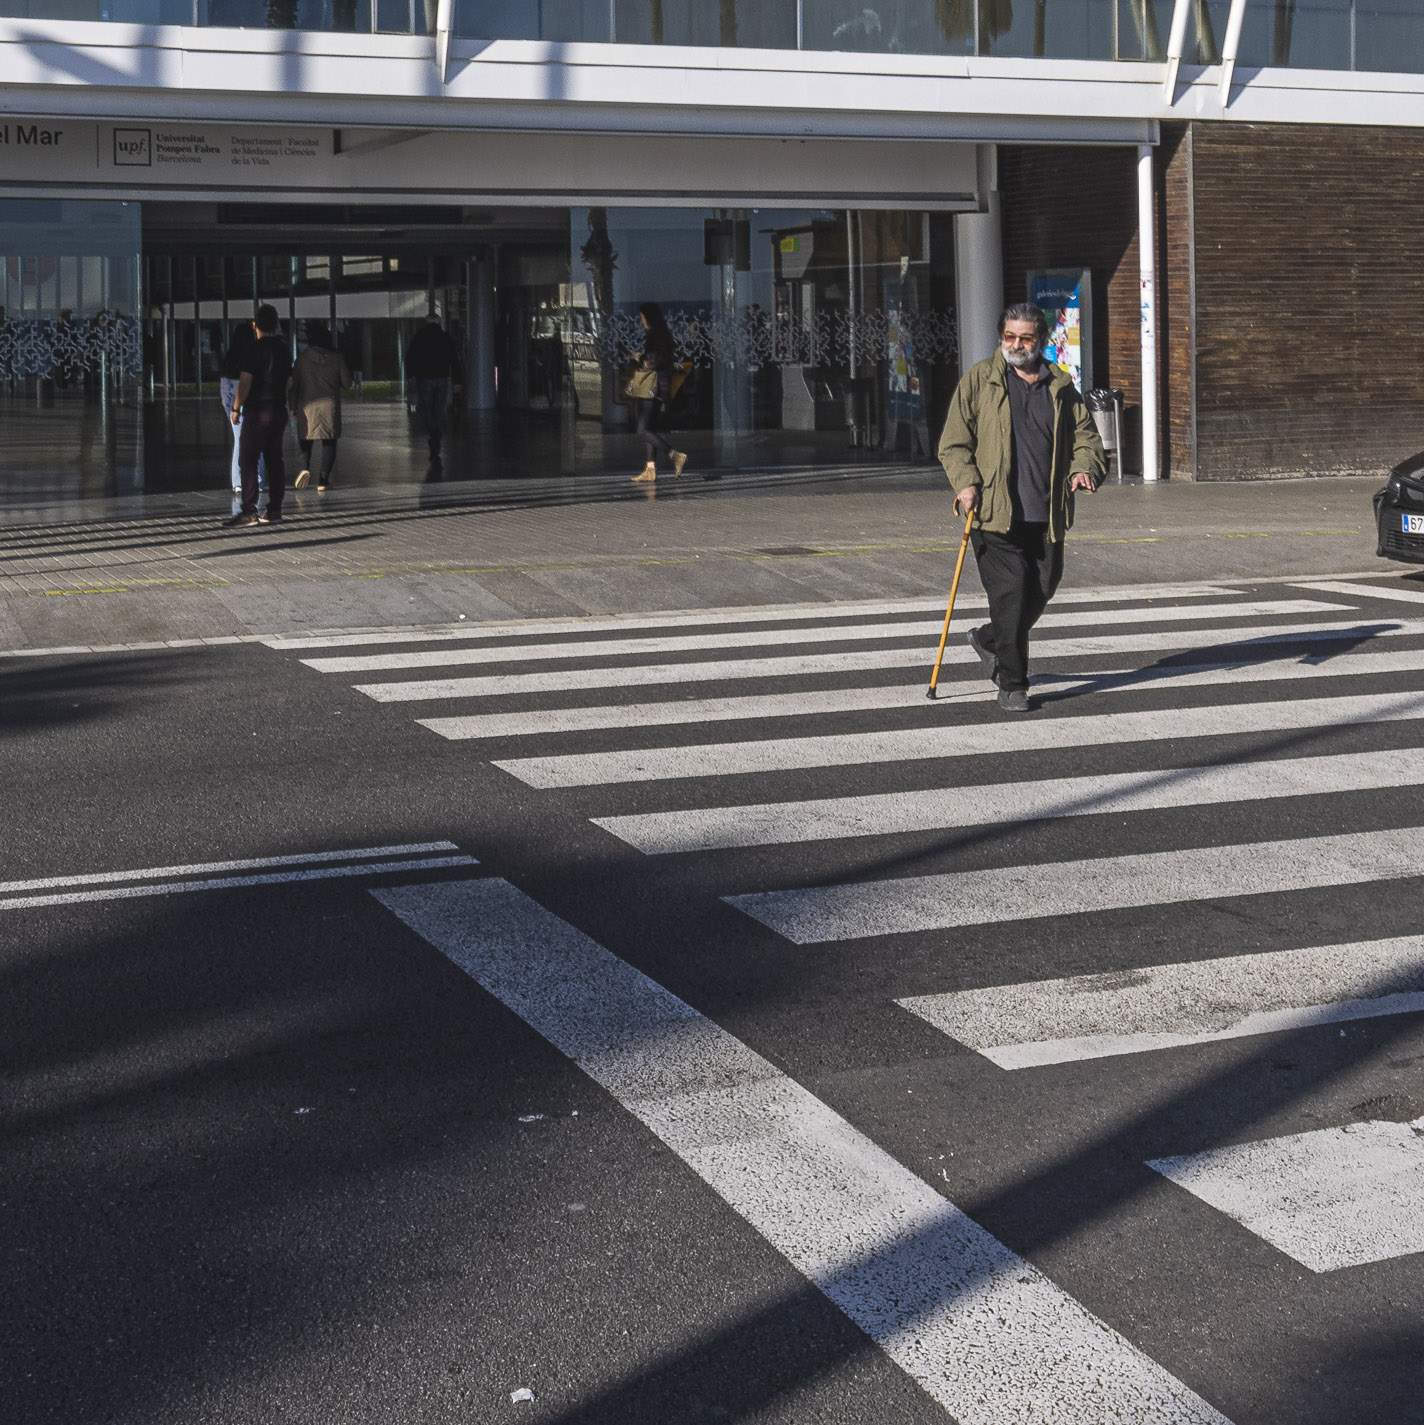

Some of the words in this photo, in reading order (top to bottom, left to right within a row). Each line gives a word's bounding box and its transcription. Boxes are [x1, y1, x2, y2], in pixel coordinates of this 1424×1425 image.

[17, 125, 64, 146] Mar
[156, 133, 205, 144] Universitat
[156, 144, 193, 155] Pompeu
[194, 144, 221, 154] Fabra
[156, 154, 203, 164] Barcelona
